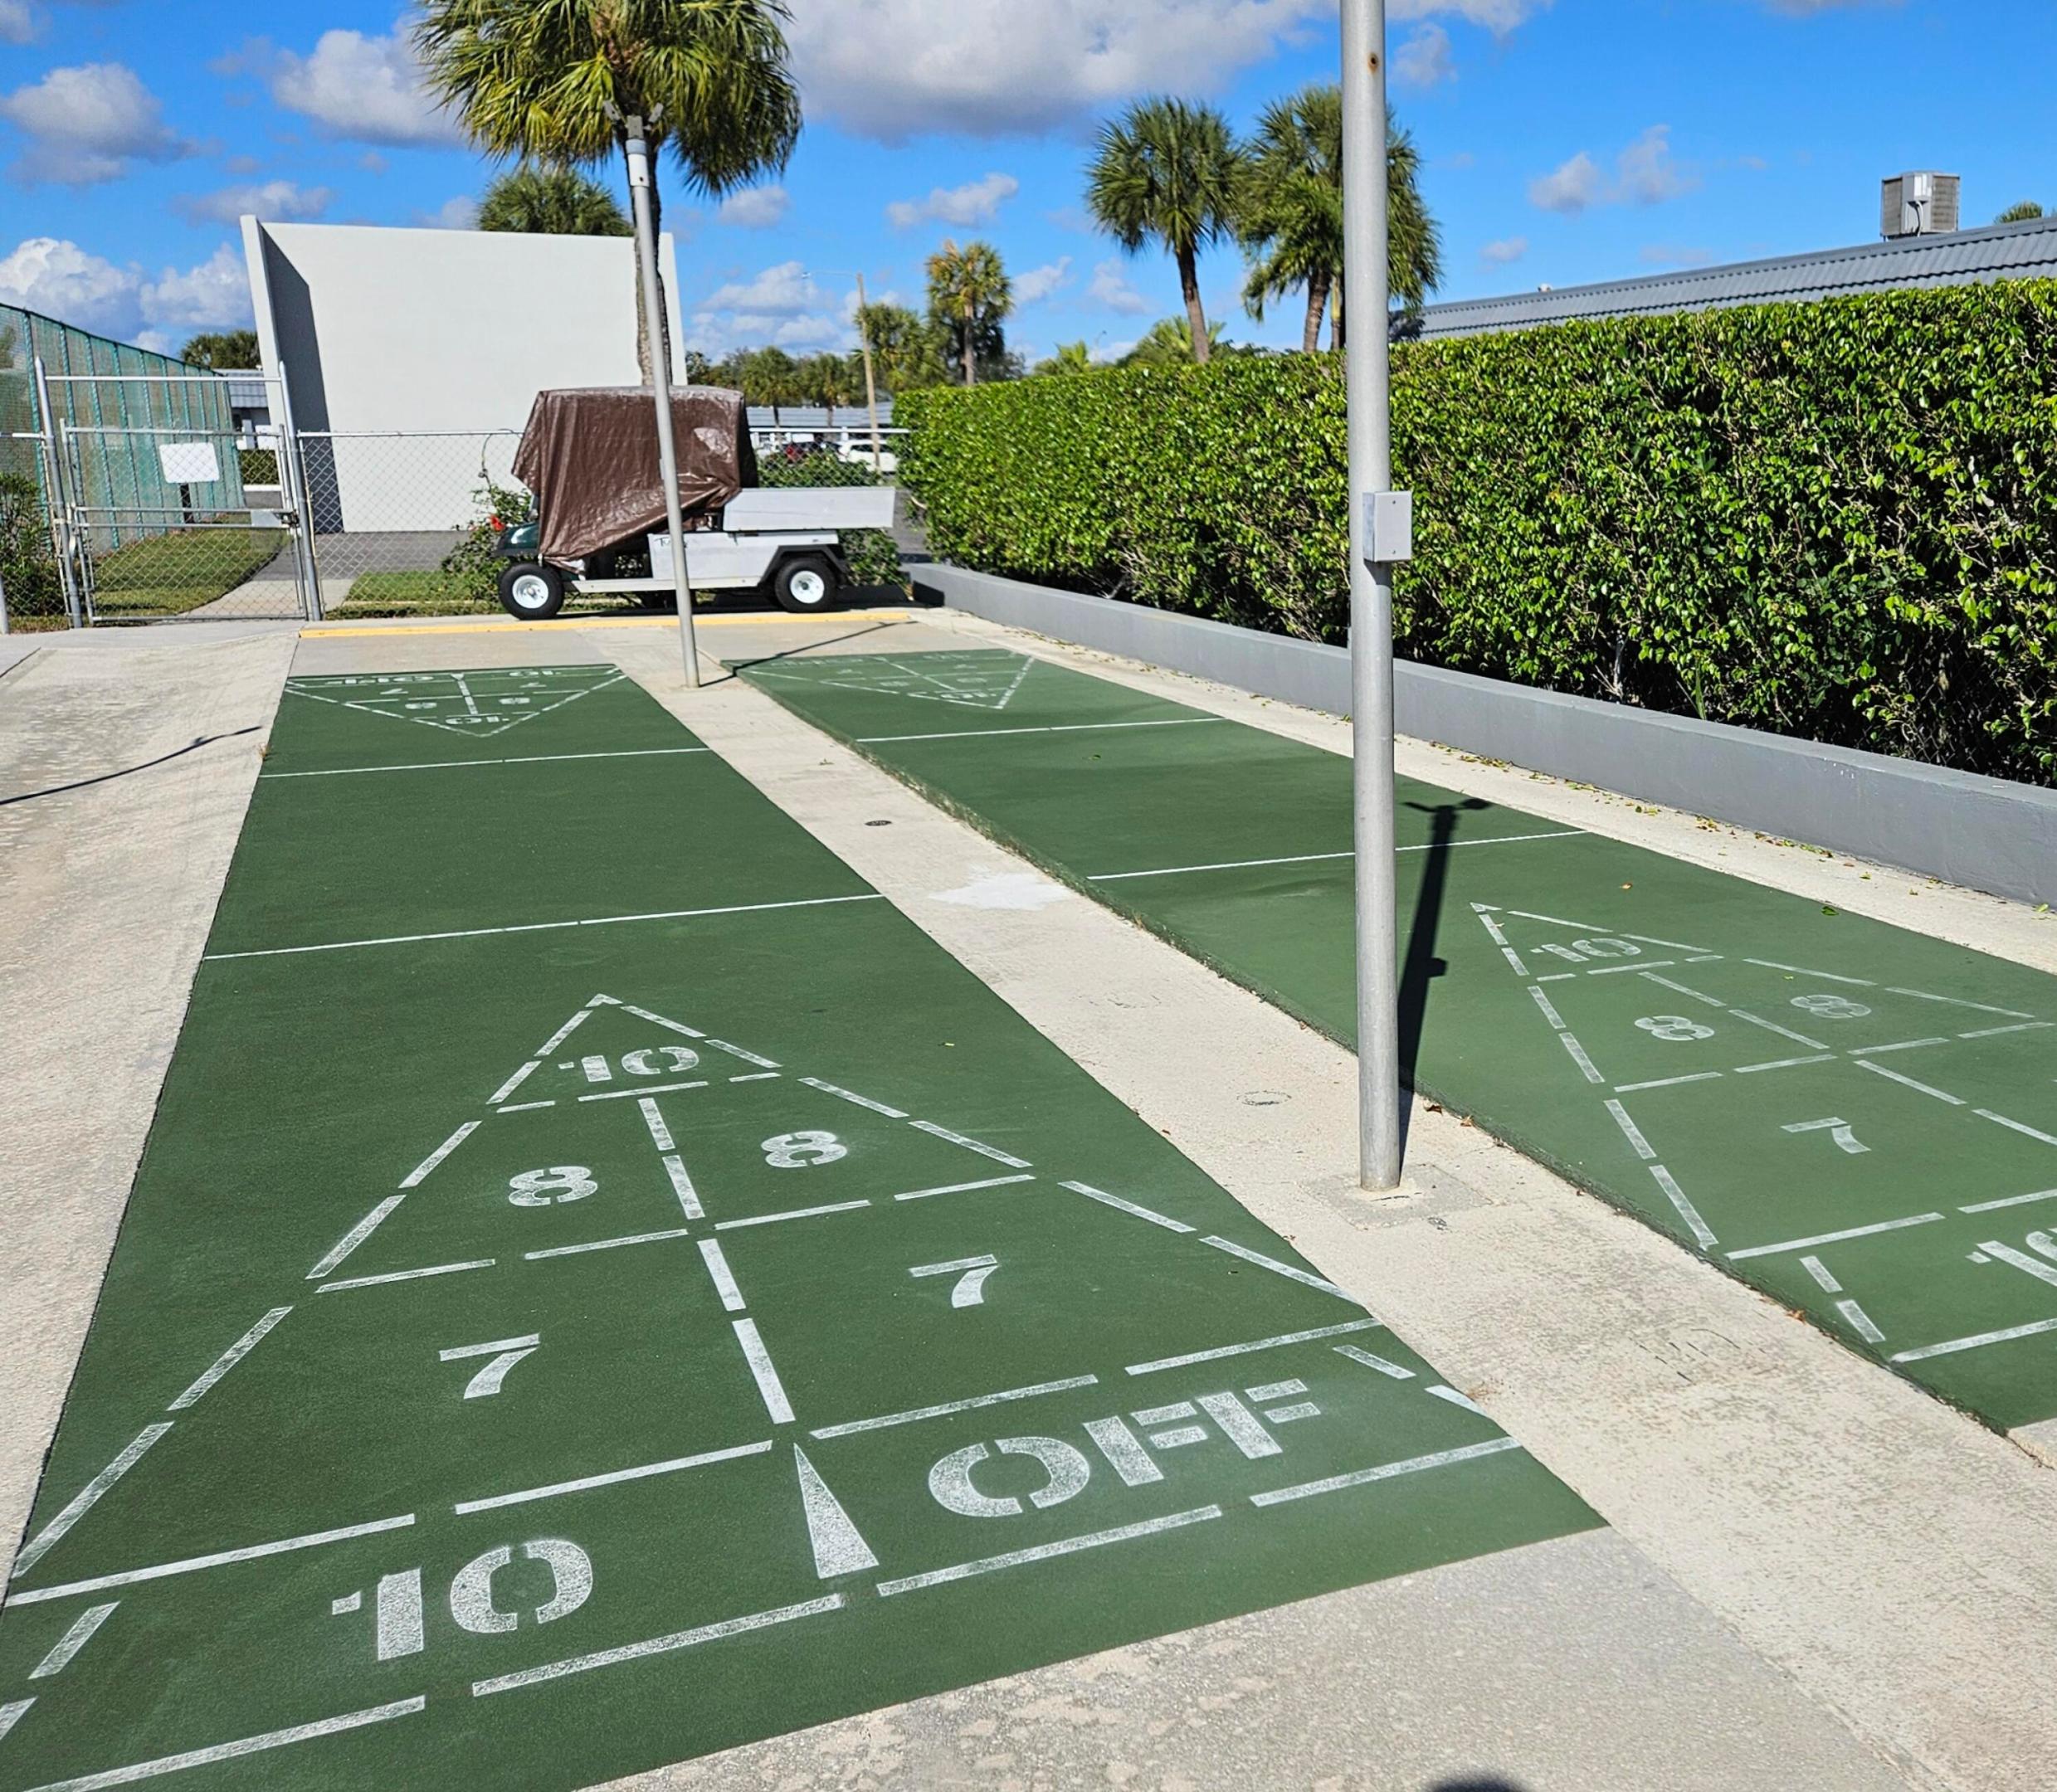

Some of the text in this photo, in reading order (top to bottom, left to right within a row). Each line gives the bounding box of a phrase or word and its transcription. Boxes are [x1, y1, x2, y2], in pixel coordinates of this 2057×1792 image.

[1529, 936, 1642, 963] 10
[1789, 994, 1872, 1020] 8
[1633, 1015, 1716, 1042] 8
[558, 1045, 701, 1083] 10
[761, 1130, 849, 1169] 8
[1780, 1116, 1872, 1155] 7
[507, 1166, 599, 1208] 8
[909, 1254, 1000, 1309] 7
[439, 1332, 540, 1400] 7
[928, 1377, 1322, 1518] OFF
[331, 1537, 596, 1662] 10
